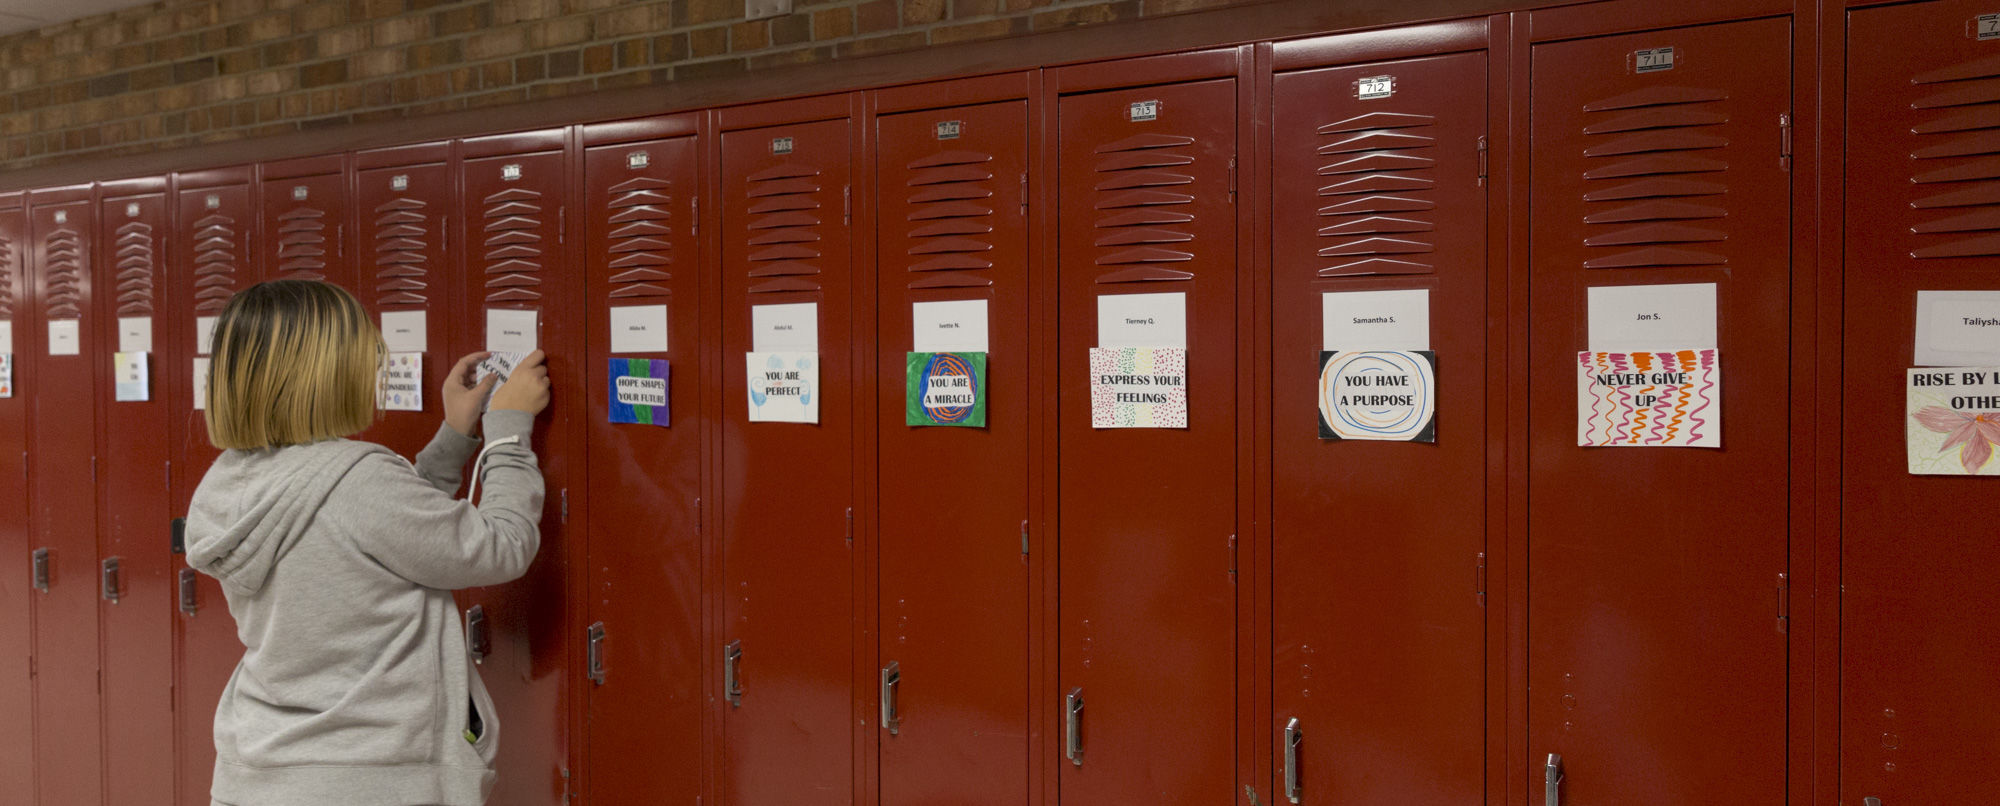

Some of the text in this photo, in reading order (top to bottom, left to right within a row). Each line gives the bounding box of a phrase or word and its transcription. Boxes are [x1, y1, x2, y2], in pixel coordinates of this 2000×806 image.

[1643, 54, 1665, 66] 711
[1366, 82, 1385, 93] 712
[1135, 106, 1151, 116] 713
[942, 126, 956, 135] 714
[1353, 316, 1388, 324] Samantha
[1636, 313, 1651, 321] Jon
[1962, 317, 2000, 328] Taliysh
[765, 371, 800, 381] YOU ARE
[1100, 375, 1181, 386] EXPRESS YOUR
[1344, 375, 1409, 387] YOU HAVE
[1596, 372, 1688, 386] NEVER GIVE
[1913, 372, 1956, 386] RISE
[1962, 371, 1987, 385] BY
[618, 378, 665, 390] HOPE SHAPES
[930, 378, 968, 388] YOU ARE
[765, 386, 800, 396] PERFECT
[618, 392, 664, 404] YOUR FUTURE
[924, 394, 972, 404] A MIRACLE
[1116, 392, 1167, 404] FEELINGS
[1340, 395, 1415, 406] A PURPOSE
[1635, 394, 1657, 407] UP
